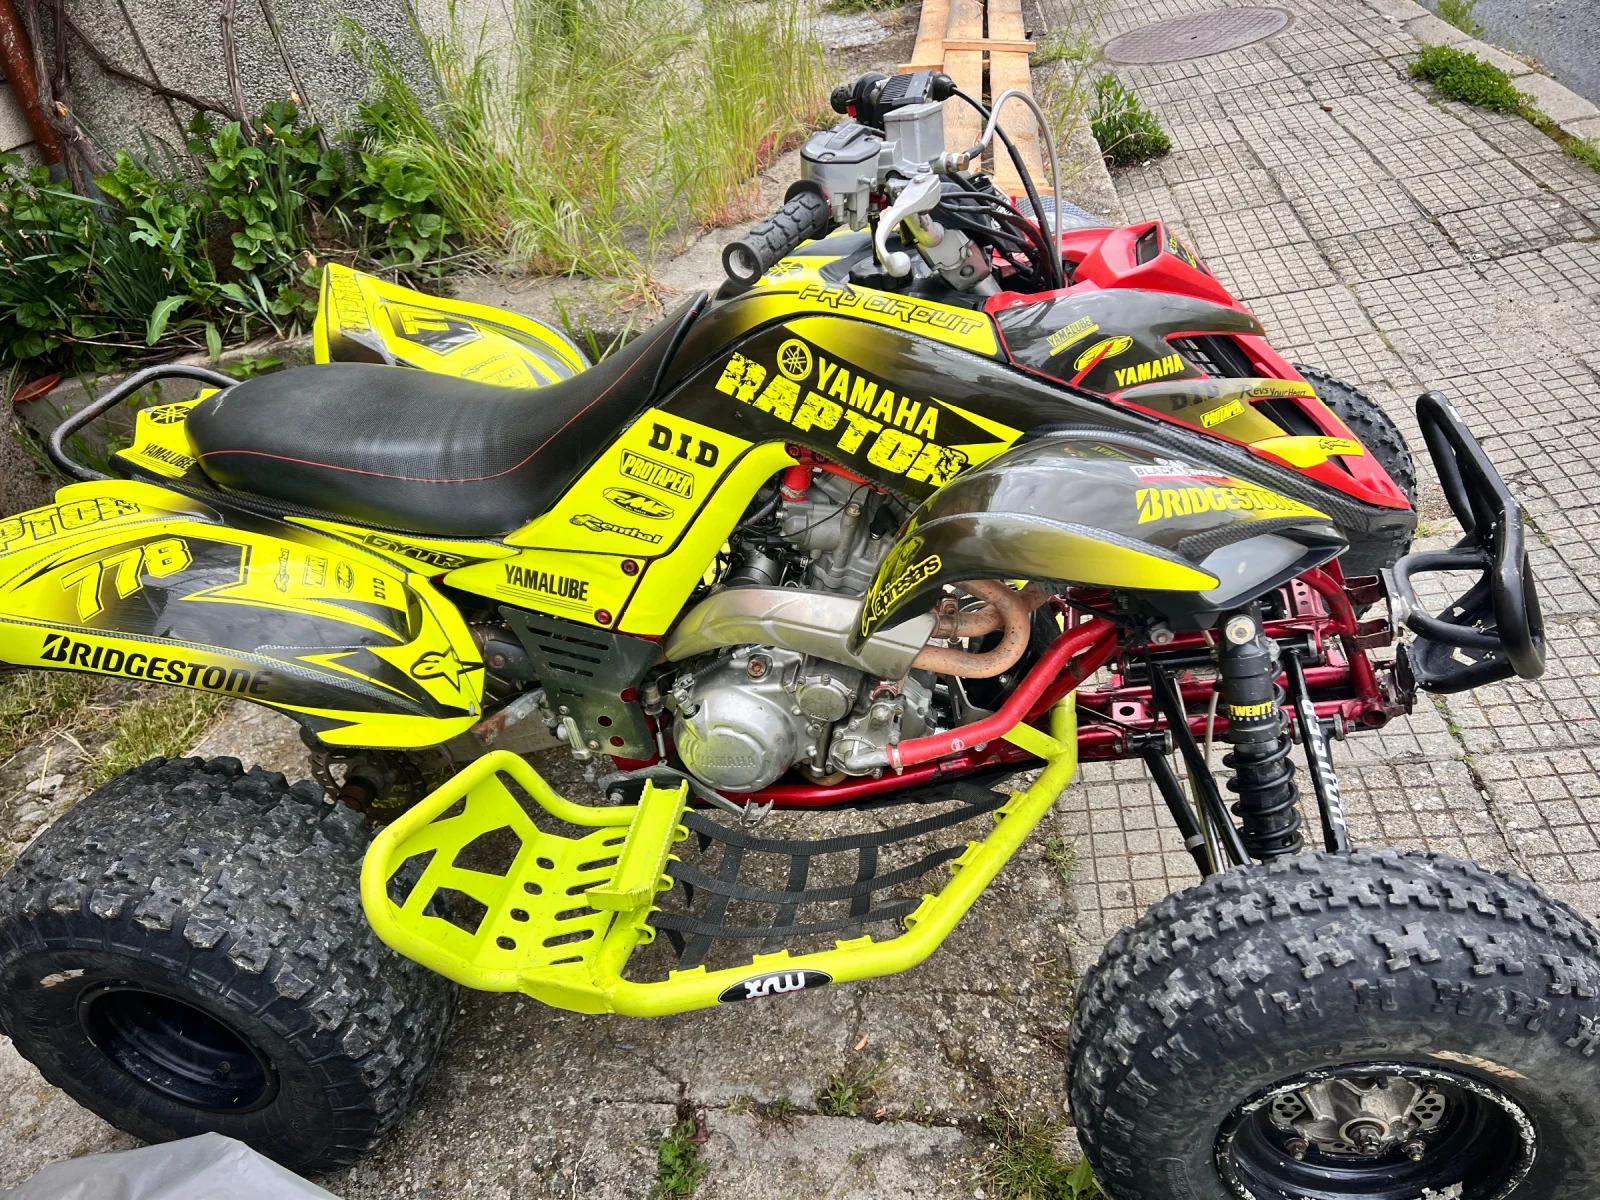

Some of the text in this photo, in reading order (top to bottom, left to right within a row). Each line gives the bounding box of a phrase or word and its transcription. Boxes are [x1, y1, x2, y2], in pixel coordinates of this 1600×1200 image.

[798, 284, 988, 337] PRO CIRCUIT
[1045, 315, 1095, 348] YAMALUBE
[1114, 353, 1185, 387] YAMAHA
[714, 351, 969, 487] RAPTOR
[817, 357, 939, 440] YAMAHA
[140, 443, 197, 471] YAMALUBE
[648, 423, 719, 468] D.I.D
[602, 488, 675, 517] FMF
[1135, 487, 1303, 525] BRIDGESTONE
[60, 537, 193, 623] 778
[504, 563, 589, 601] YAMALUBE
[40, 633, 272, 695] BRIDGESTONE
